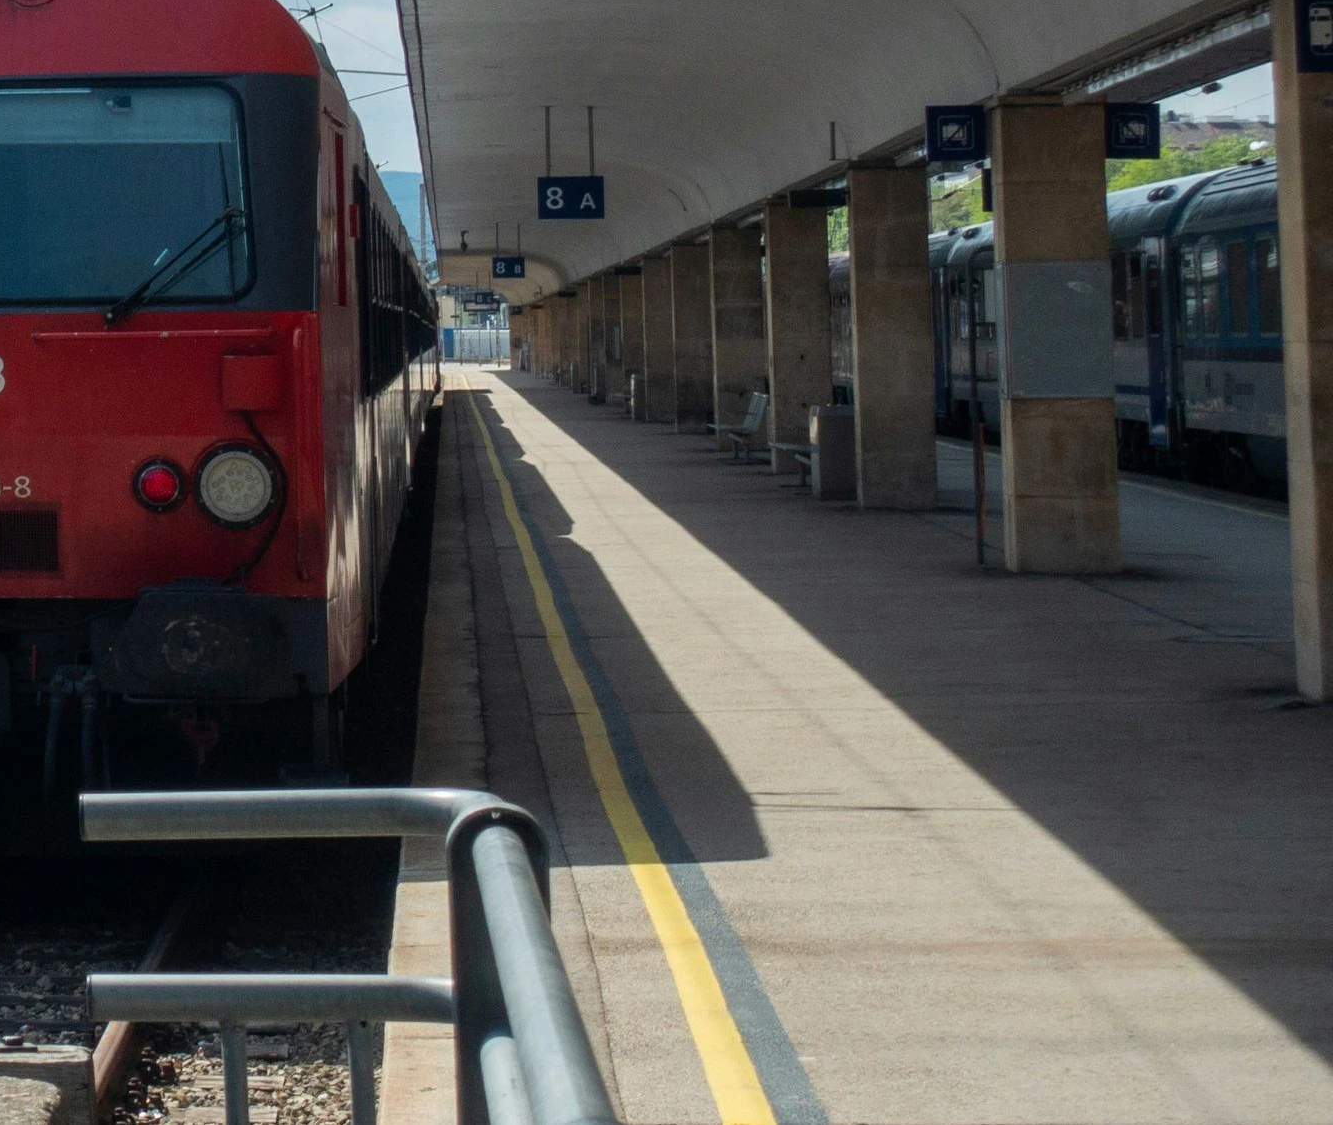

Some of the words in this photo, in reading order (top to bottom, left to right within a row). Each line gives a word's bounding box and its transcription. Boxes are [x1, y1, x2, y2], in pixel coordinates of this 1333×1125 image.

[546, 187, 564, 210] 8
[580, 193, 596, 209] A
[496, 262, 506, 274] 8
[514, 265, 522, 274] B
